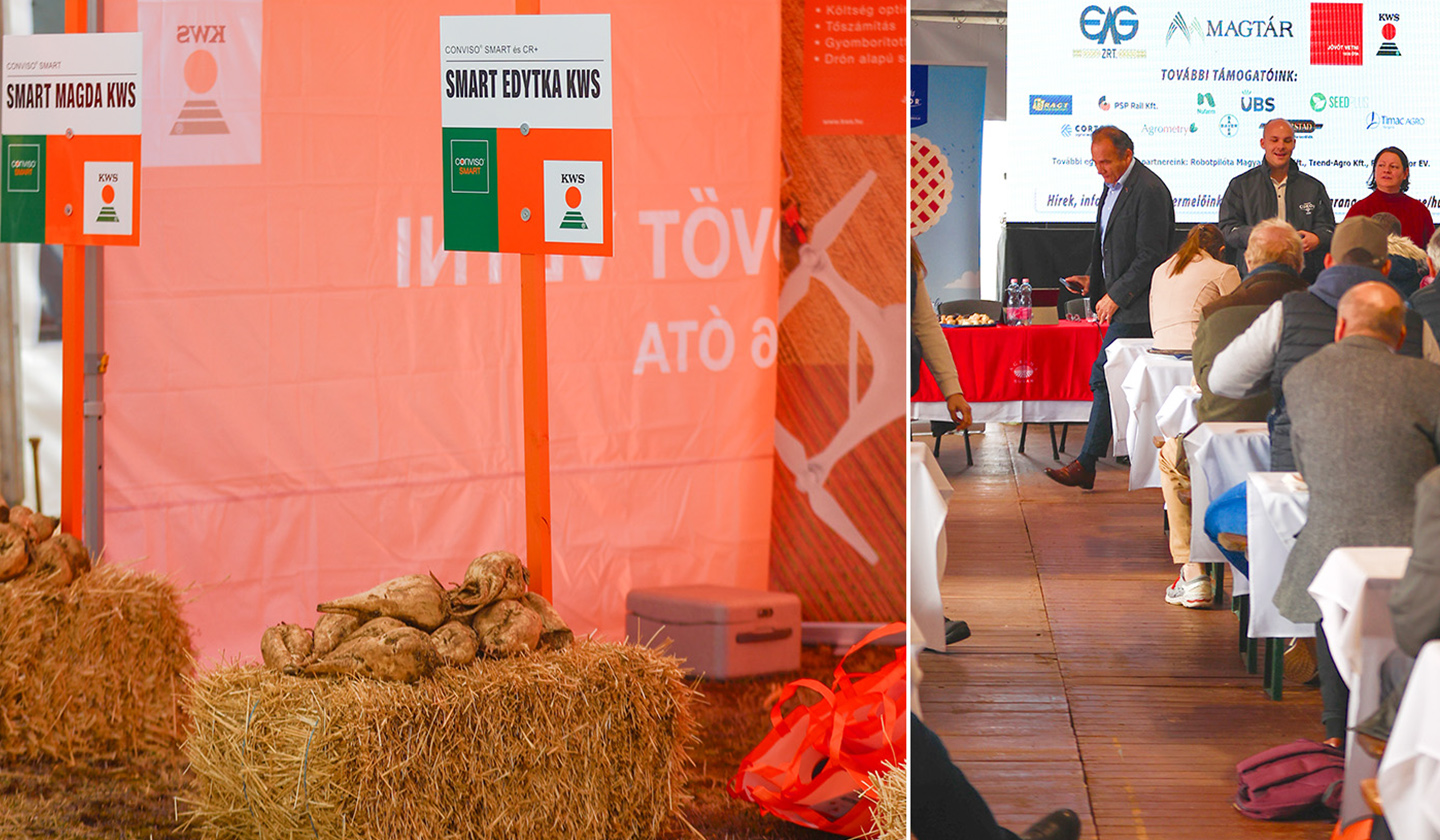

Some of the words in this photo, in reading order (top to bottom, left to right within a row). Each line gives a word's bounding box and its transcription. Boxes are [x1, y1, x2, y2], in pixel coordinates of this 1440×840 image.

[878, 4, 906, 16] opti
[1378, 13, 1400, 22] KWS
[1206, 16, 1294, 38] MAGTÁR
[484, 45, 511, 54] SMART
[522, 45, 538, 54] CR+
[824, 37, 906, 51] Gyomborítot
[1161, 67, 1210, 82] TOVÁBBI
[1212, 67, 1298, 82] TÁMOGATÓINK:
[445, 69, 498, 99] SMART
[502, 69, 562, 98] EDYTKA
[566, 69, 601, 98] KWS
[6, 82, 51, 109] SMART
[55, 82, 103, 108] MAGDA
[107, 81, 136, 108] KWS
[1075, 124, 1099, 133] CORT
[1141, 123, 1189, 136] Agrometry
[1237, 157, 1262, 168] Magya
[1309, 158, 1351, 168] Trend-Agro
[459, 167, 481, 175] SMART
[98, 173, 119, 183] KWS
[561, 173, 586, 184] KWS
[1047, 194, 1078, 208] Hírek,
[1080, 193, 1101, 207] info
[1173, 194, 1223, 207] ermelőink
